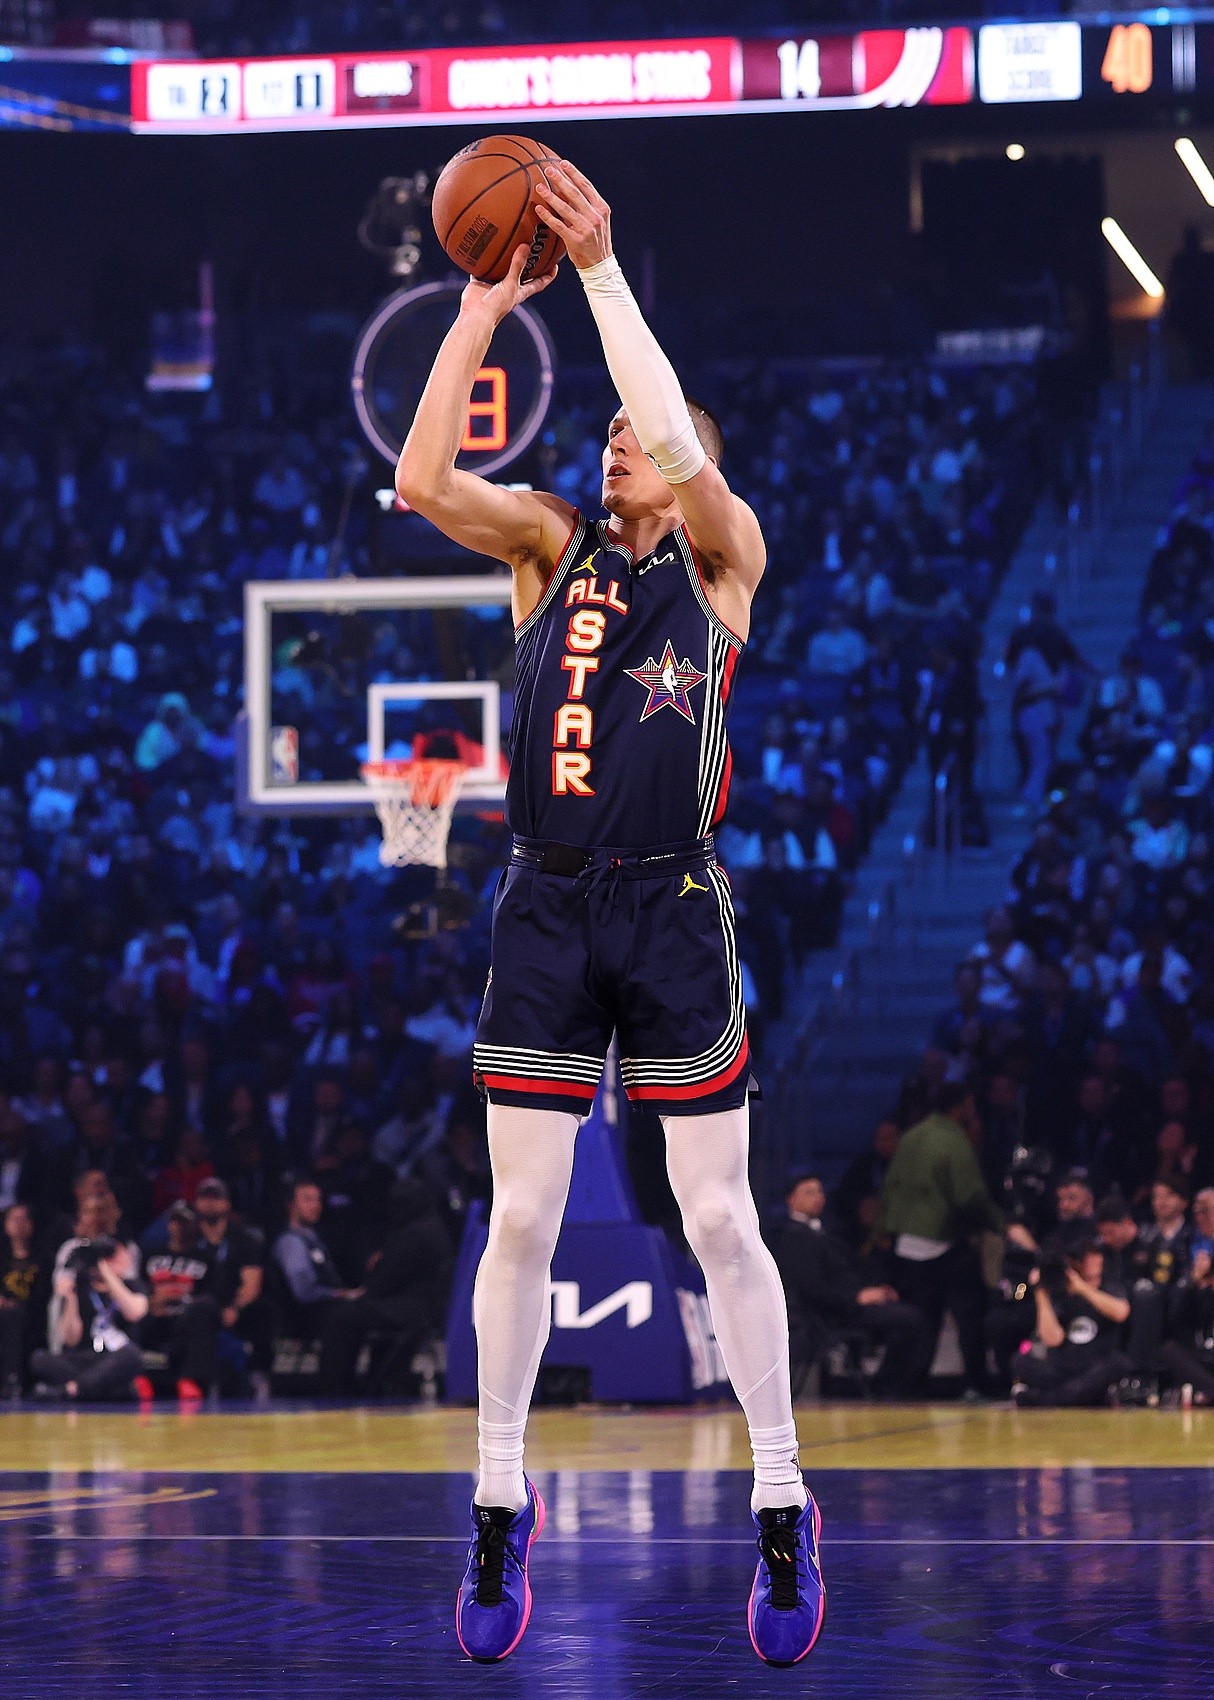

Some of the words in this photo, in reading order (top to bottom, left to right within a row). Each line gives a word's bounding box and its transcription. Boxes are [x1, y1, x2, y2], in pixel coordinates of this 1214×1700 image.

[777, 39, 821, 100] 14
[1100, 23, 1152, 94] 40
[565, 577, 629, 615] ALL
[552, 609, 606, 796] STAR
